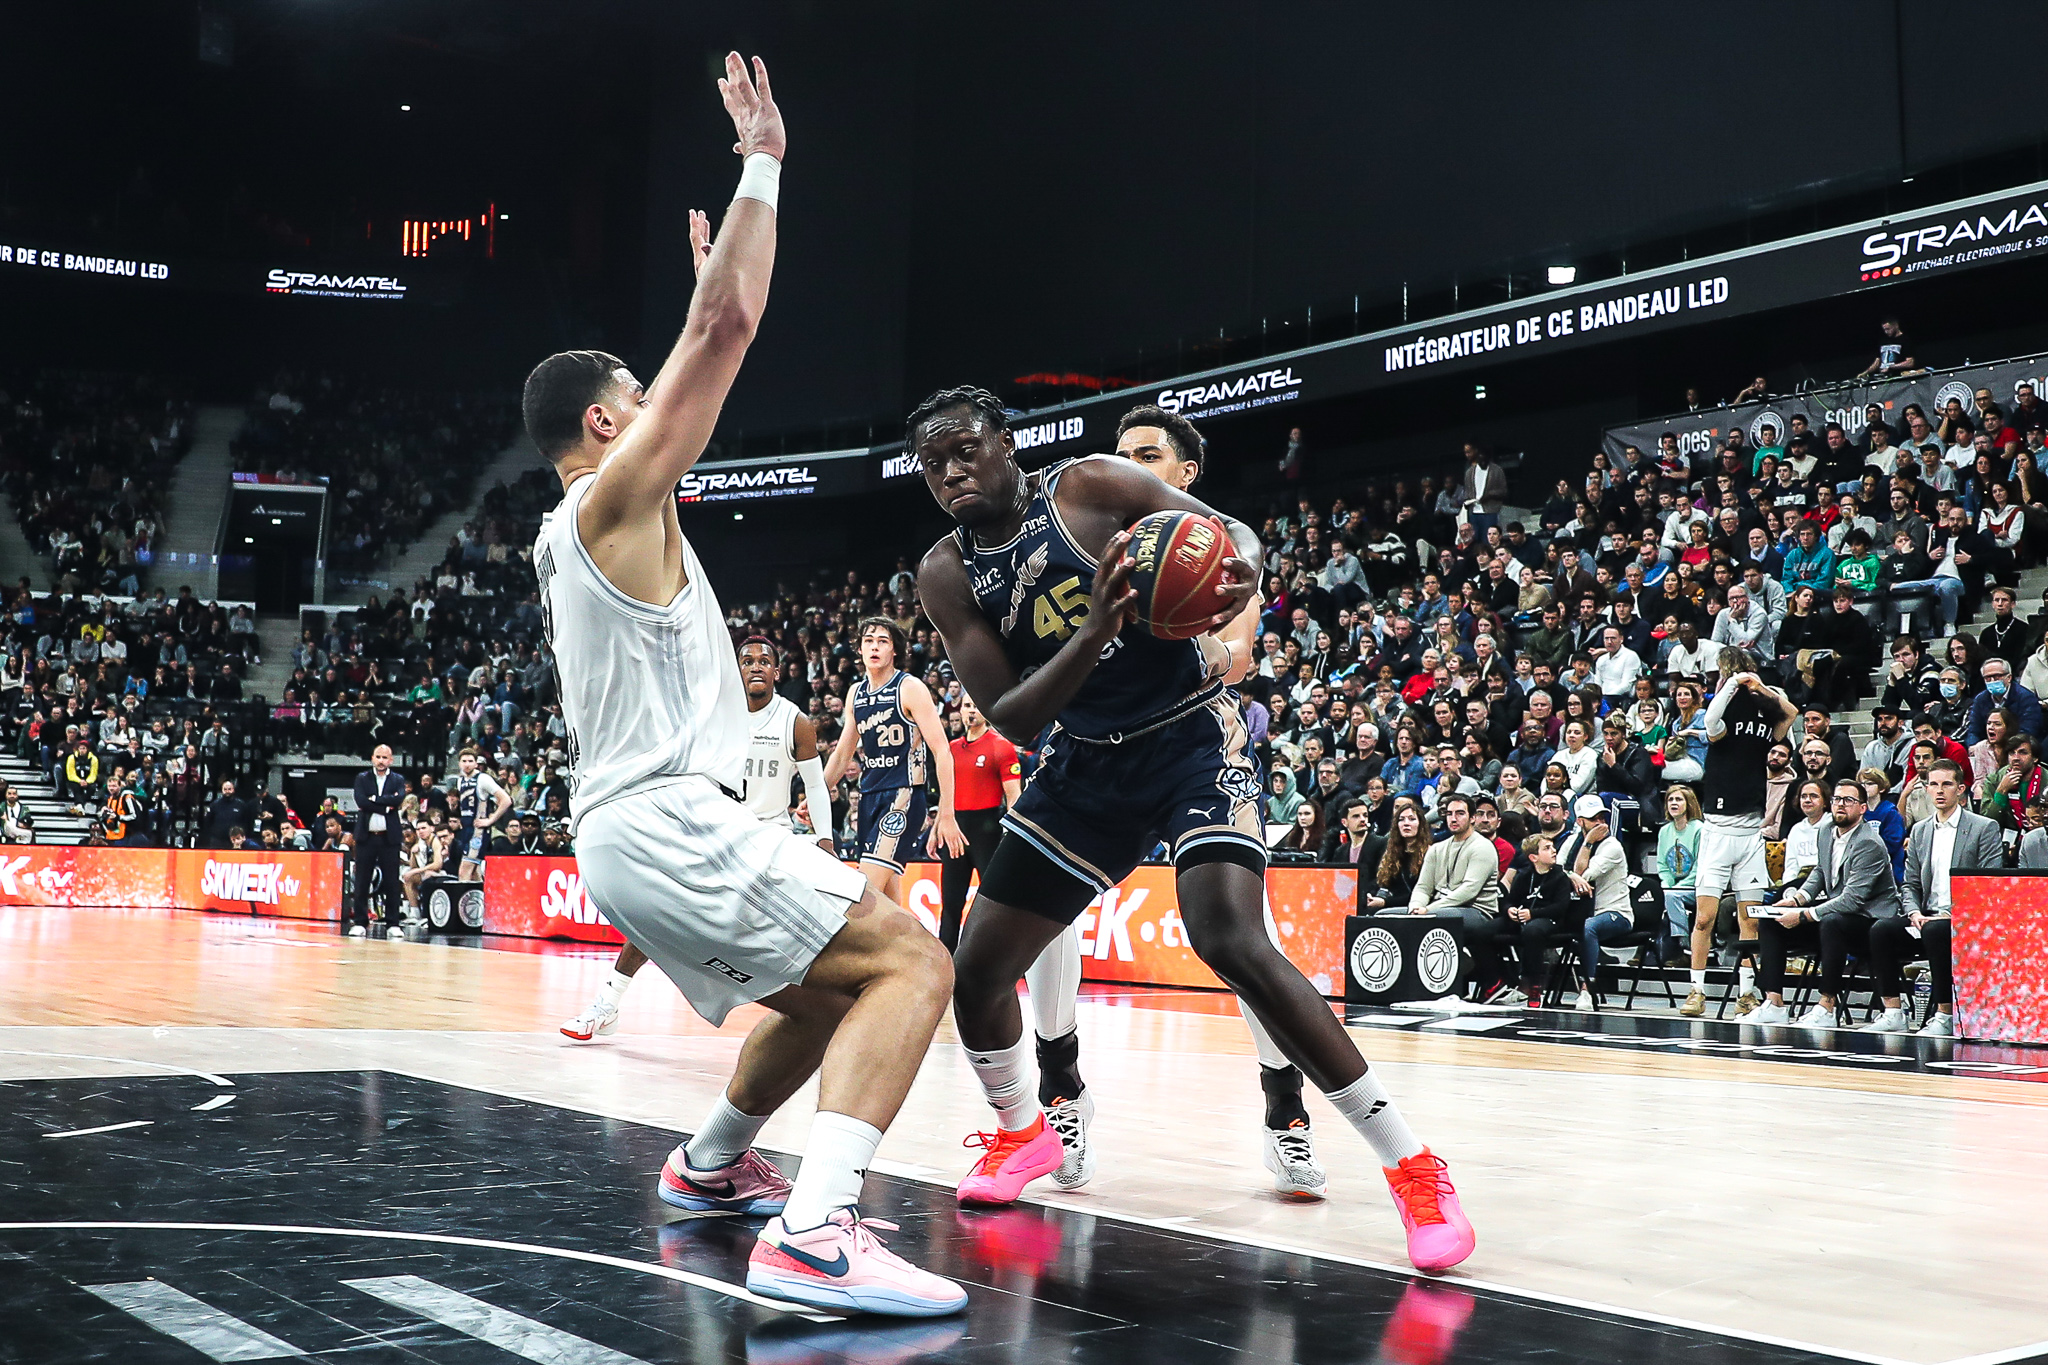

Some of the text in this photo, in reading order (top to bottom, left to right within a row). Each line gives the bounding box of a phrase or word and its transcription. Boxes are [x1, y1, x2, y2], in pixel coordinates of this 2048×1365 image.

[1860, 202, 2048, 272] STRAMA
[0, 245, 169, 279] R DE CE BANDEAU LED
[1905, 254, 1955, 273] AFFICHAGE
[2025, 238, 2033, 249] &
[265, 268, 407, 291] STRAMATEL
[1385, 276, 1729, 372] INTÉGRATEUR DE CE BANDEAU LED
[1157, 367, 1302, 414] STRAMATEL
[1058, 416, 1084, 442] LED
[677, 467, 818, 497] STRAMATEL
[1034, 575, 1092, 641] 45
[876, 723, 905, 747] 20
[1735, 721, 1773, 742] PARI
[1716, 797, 1724, 809] 2
